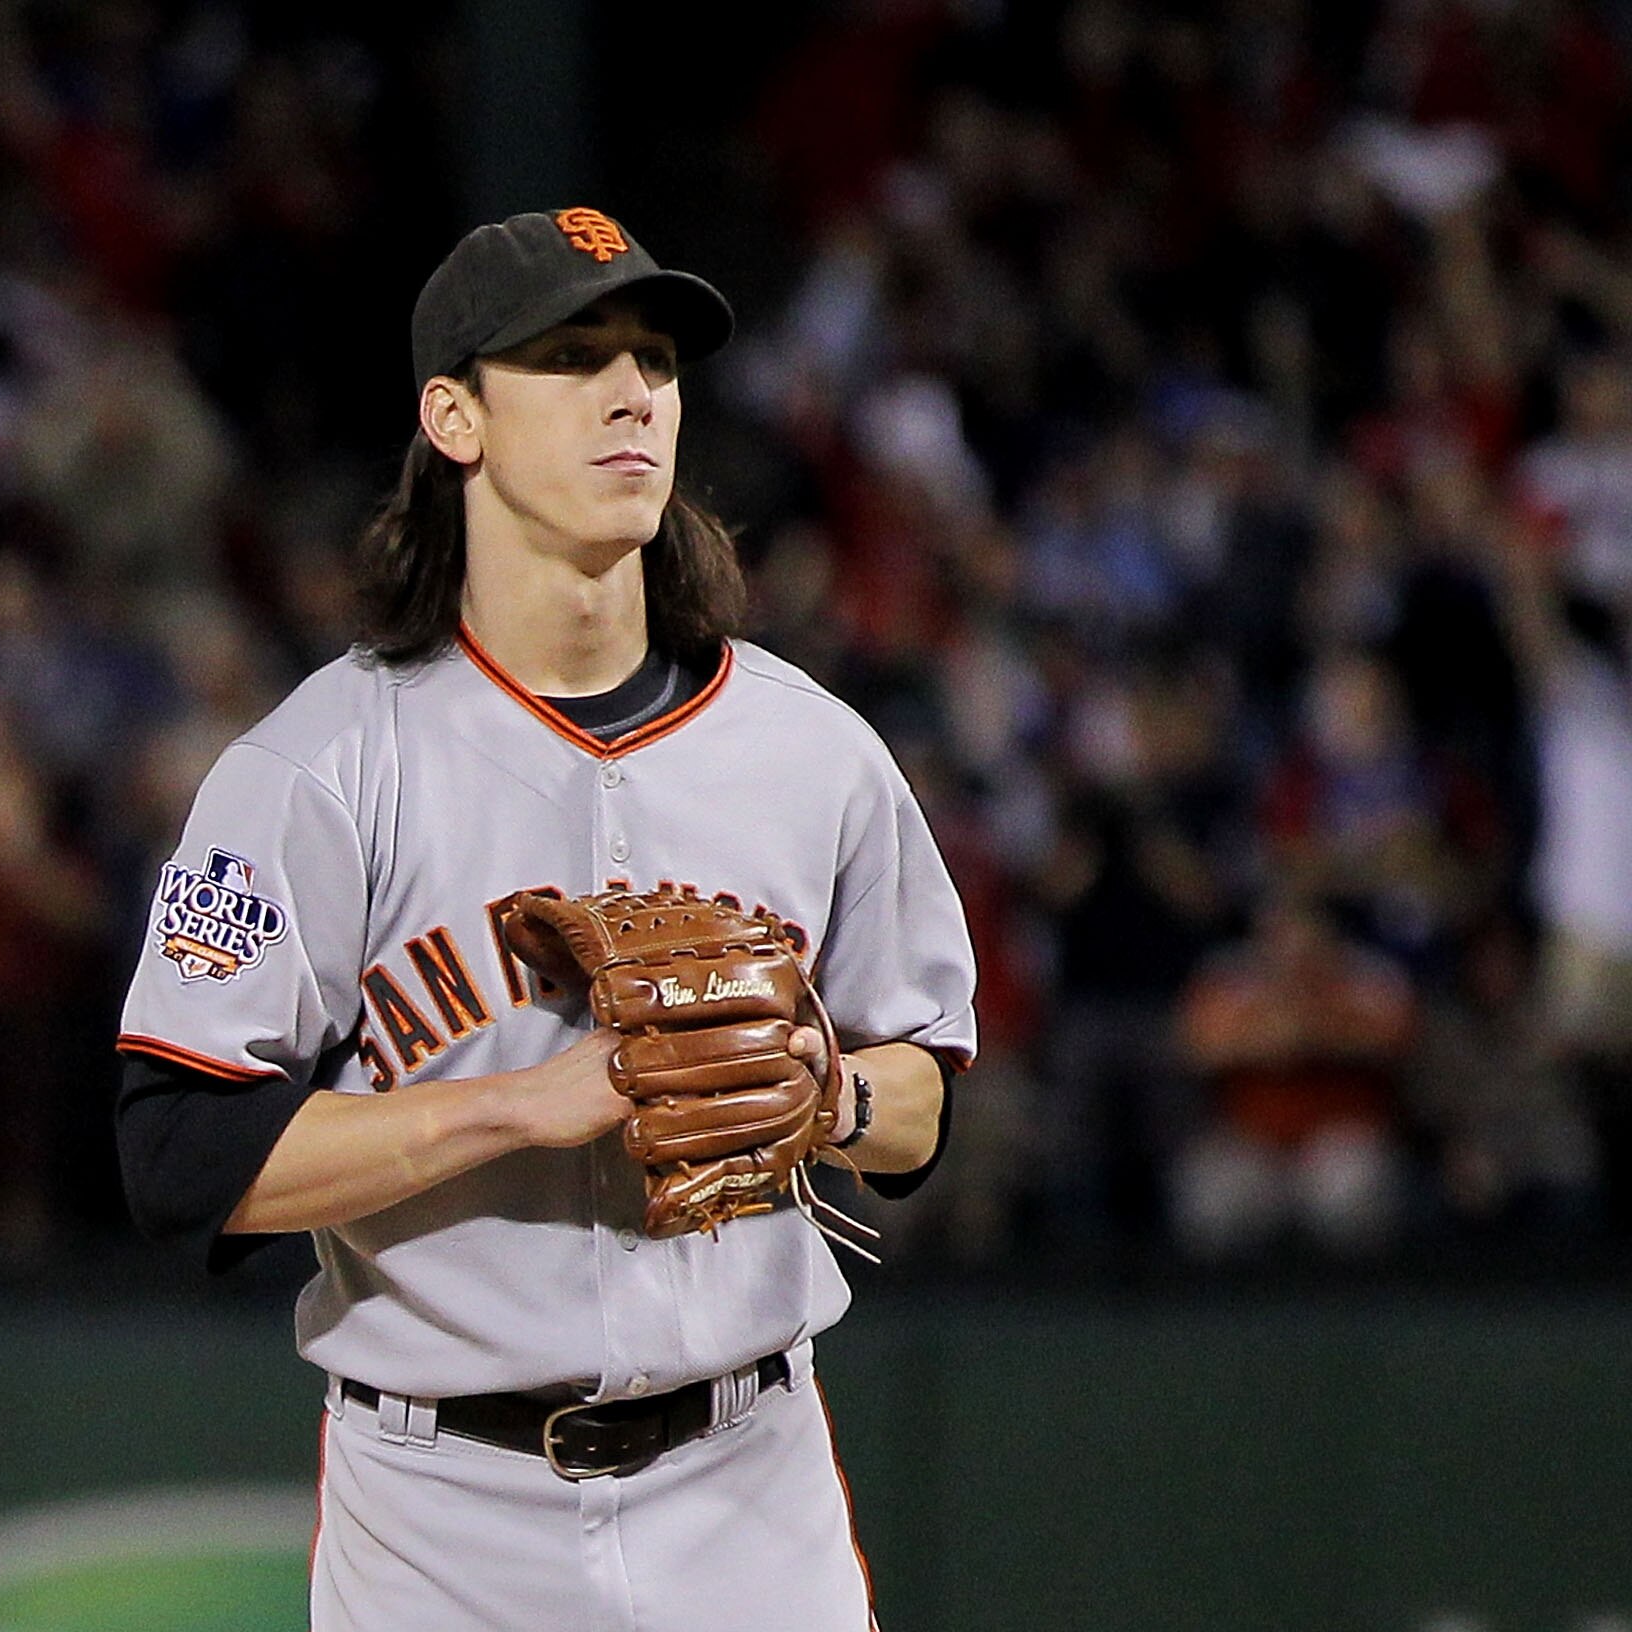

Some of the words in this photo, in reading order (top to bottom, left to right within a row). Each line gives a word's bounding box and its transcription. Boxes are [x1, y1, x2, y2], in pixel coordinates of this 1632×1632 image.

[160, 864, 287, 938] WORLD
[156, 902, 261, 963] SERIES
[658, 977, 696, 1007] Tim
